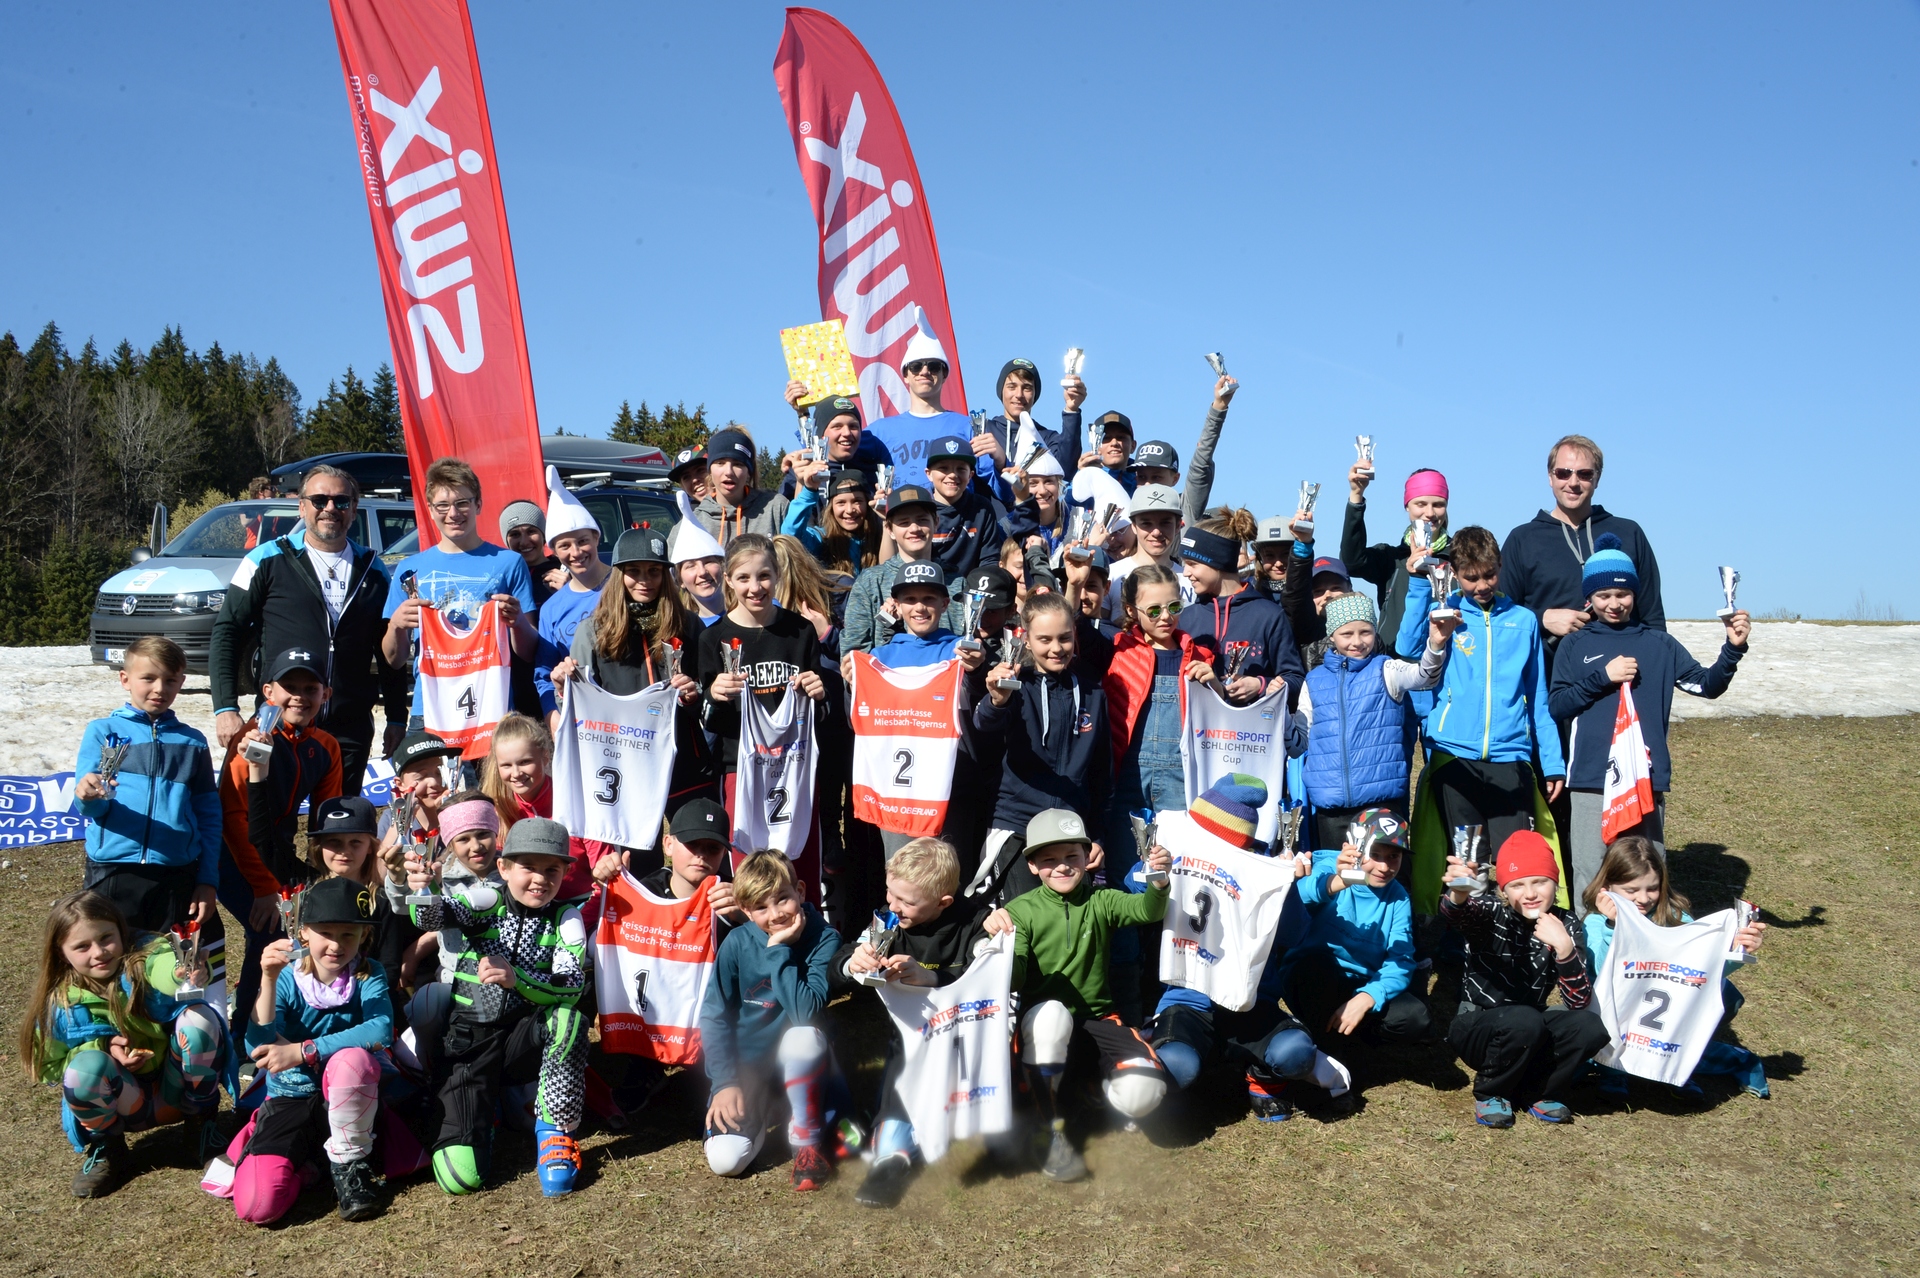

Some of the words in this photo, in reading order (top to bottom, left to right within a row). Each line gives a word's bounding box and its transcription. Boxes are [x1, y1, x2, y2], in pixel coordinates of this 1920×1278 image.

[1183, 550, 1213, 564] ziener
[967, 588, 996, 598] SCOTT
[456, 683, 478, 720] 4
[874, 708, 932, 718] Kreissparkasse
[585, 719, 657, 740] INTERSPORT
[1205, 728, 1271, 743] INTERSPORT
[578, 731, 651, 751] SCHLICHTNER
[1201, 741, 1267, 754] SCHLICHTNER
[603, 748, 622, 761] Cup
[1222, 755, 1242, 765] Cup
[893, 748, 915, 788] 2
[593, 766, 623, 806] 3
[767, 785, 793, 826] 2
[1182, 856, 1242, 892] INTERSPORT
[1189, 890, 1212, 935] 3
[621, 918, 682, 939] reissparkasse
[620, 927, 704, 953] Mesbach-Tegernsee
[1635, 961, 1706, 978] INTERSPORT
[633, 969, 650, 1012] 1
[928, 998, 996, 1029] INTERSPORT
[1638, 987, 1672, 1032] 2
[1626, 1032, 1682, 1053] NTERSPORT
[953, 1034, 970, 1082] 1
